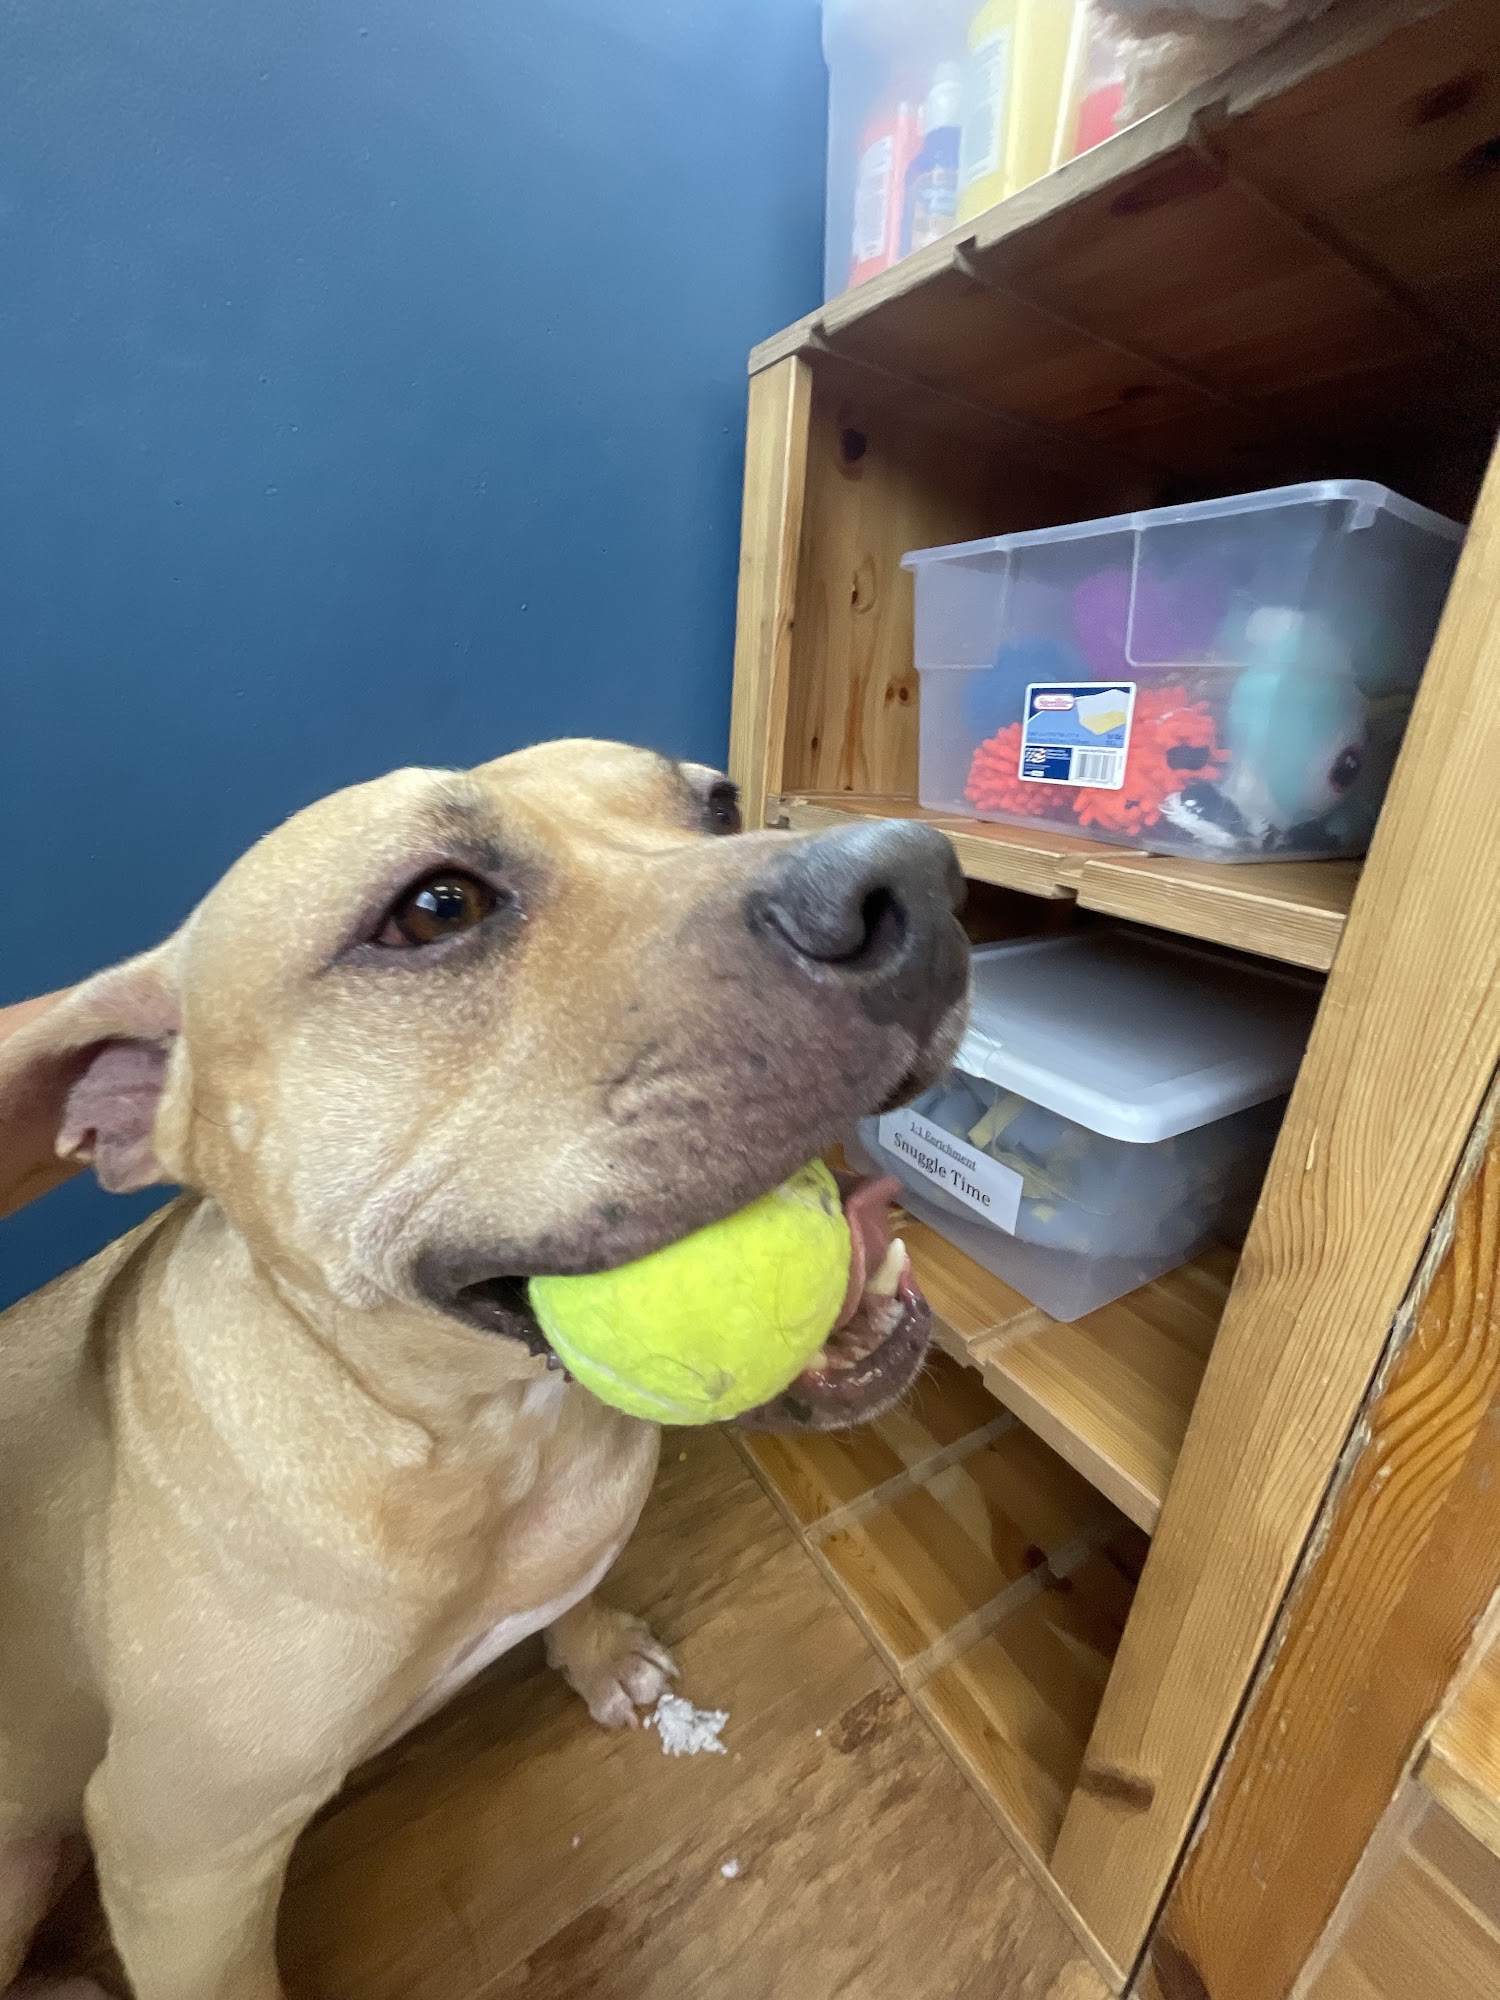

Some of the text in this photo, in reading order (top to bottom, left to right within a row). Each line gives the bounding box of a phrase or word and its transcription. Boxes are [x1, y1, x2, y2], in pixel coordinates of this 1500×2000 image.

[893, 1132, 991, 1208] Snuggle Time
[924, 1130, 977, 1172] Enrichment
